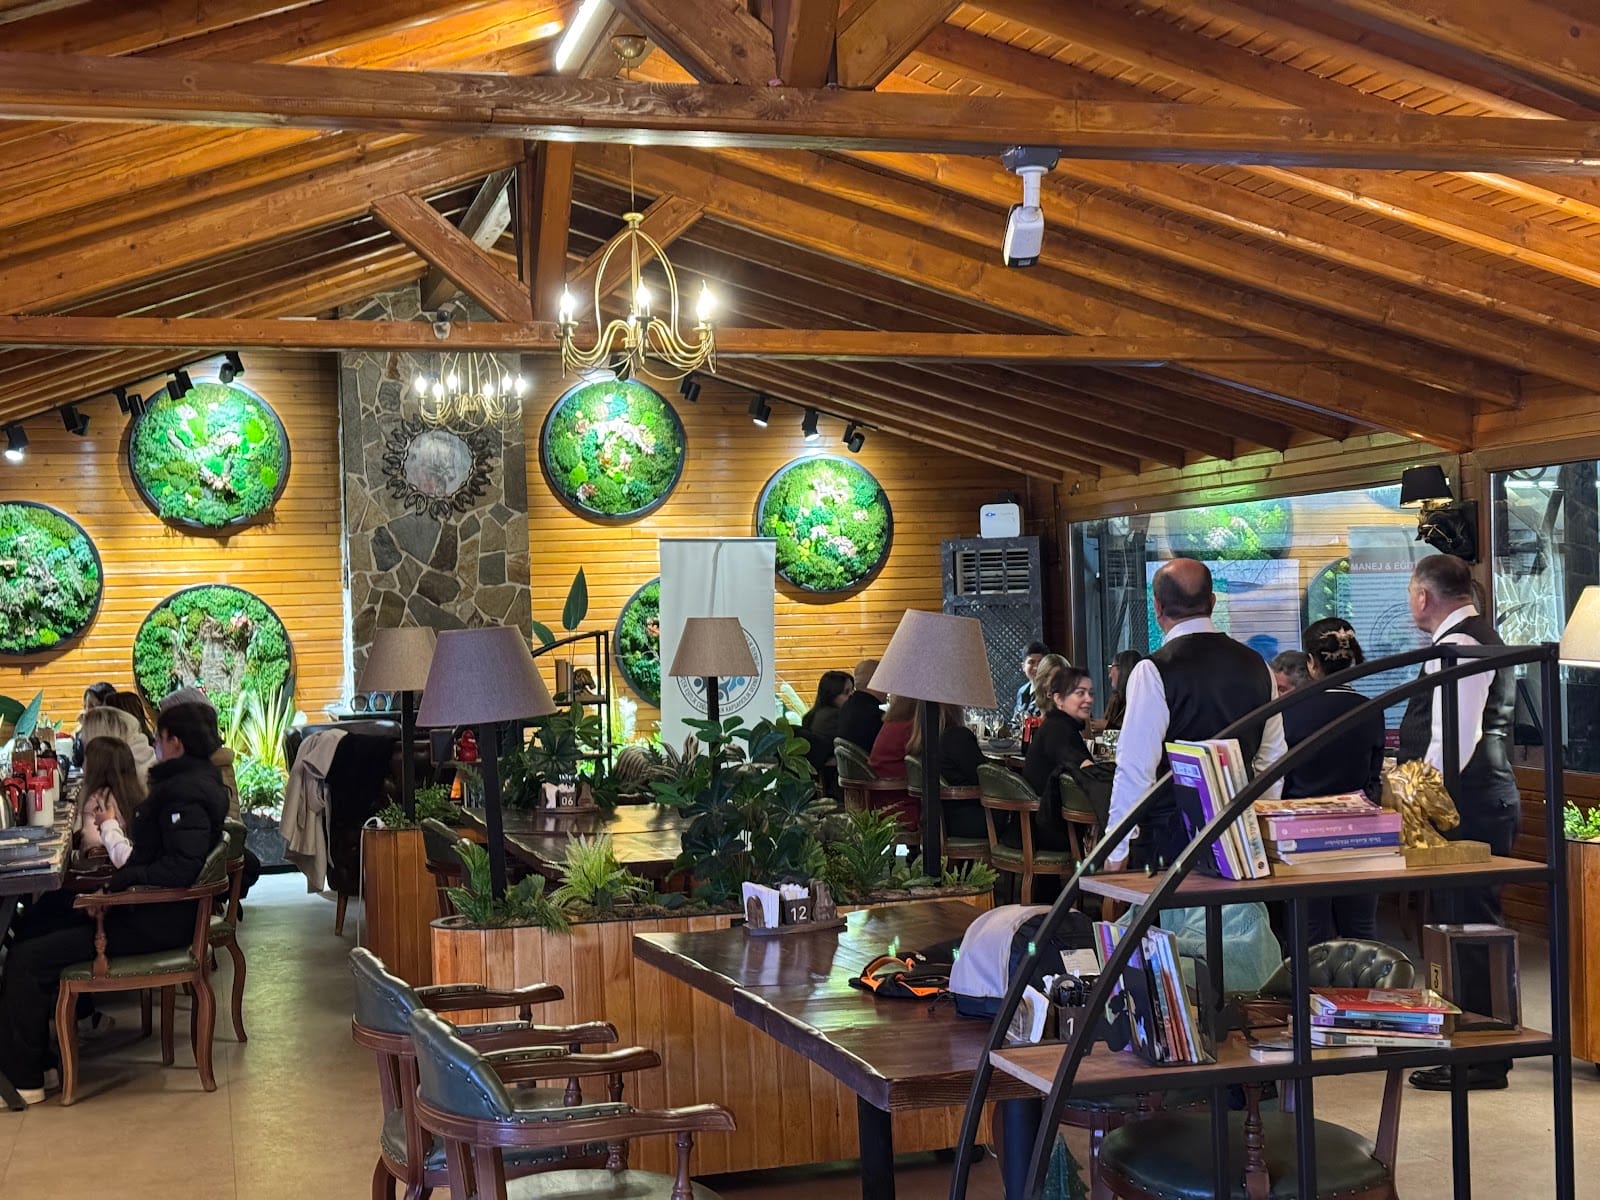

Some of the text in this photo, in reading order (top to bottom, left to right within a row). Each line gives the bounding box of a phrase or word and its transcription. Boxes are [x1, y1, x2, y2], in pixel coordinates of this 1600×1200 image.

[1350, 562, 1383, 571] MANEJ
[1384, 562, 1392, 570] &
[561, 796, 574, 806] 06
[790, 905, 808, 921] 12
